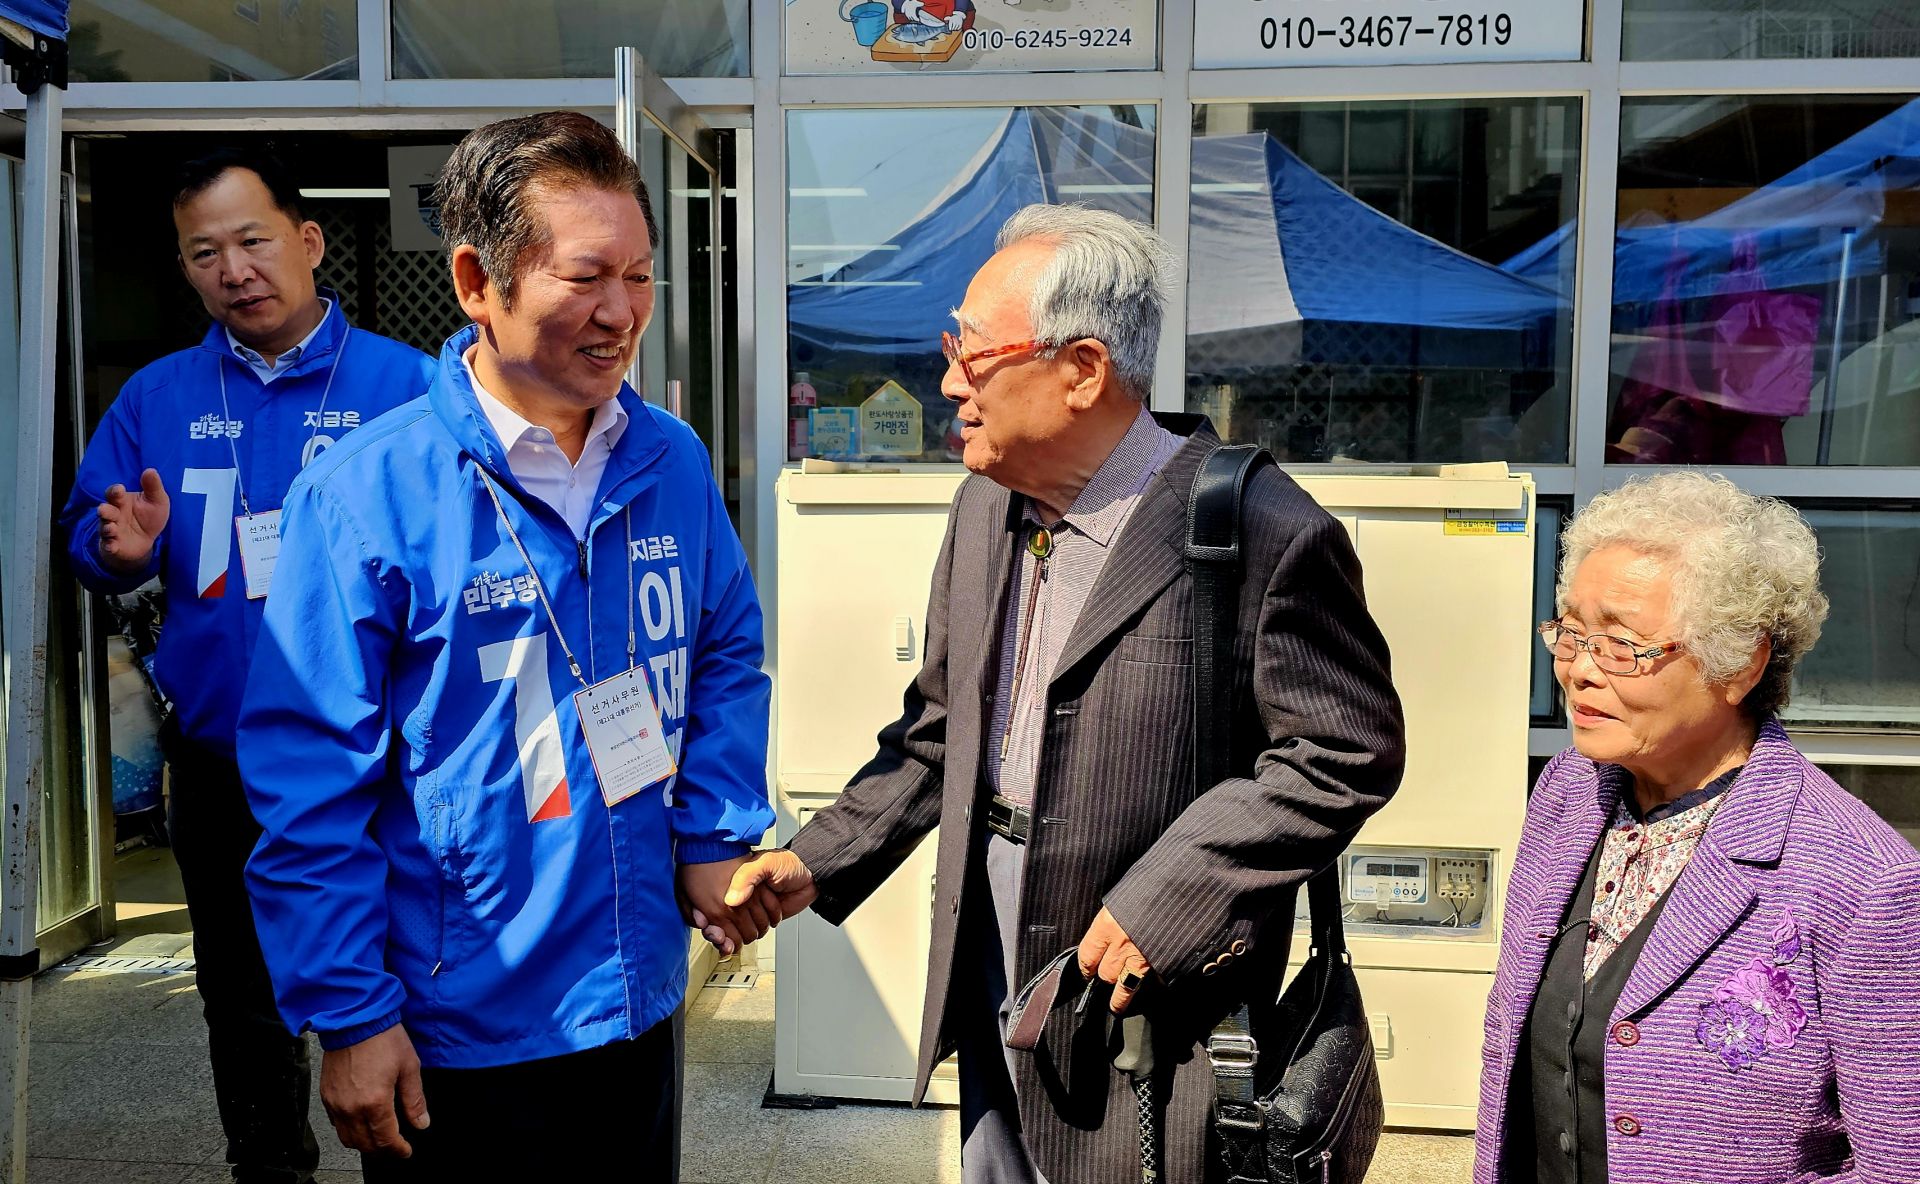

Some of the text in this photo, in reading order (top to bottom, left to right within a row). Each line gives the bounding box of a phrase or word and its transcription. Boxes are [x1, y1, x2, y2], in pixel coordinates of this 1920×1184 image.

[964, 28, 1132, 50] 010-6245-9224
[1260, 13, 1512, 49] 010-3467-7819
[189, 419, 244, 439] 민주당
[303, 411, 361, 428] 지금은
[874, 420, 909, 435] 가맹점
[181, 467, 238, 599] 1
[630, 535, 679, 562] 지금은
[472, 570, 501, 587] 더불어
[463, 574, 538, 615] 민주당
[591, 685, 640, 715] 선거사무원
[477, 632, 572, 824] 1
[596, 713, 616, 727] (제21대
